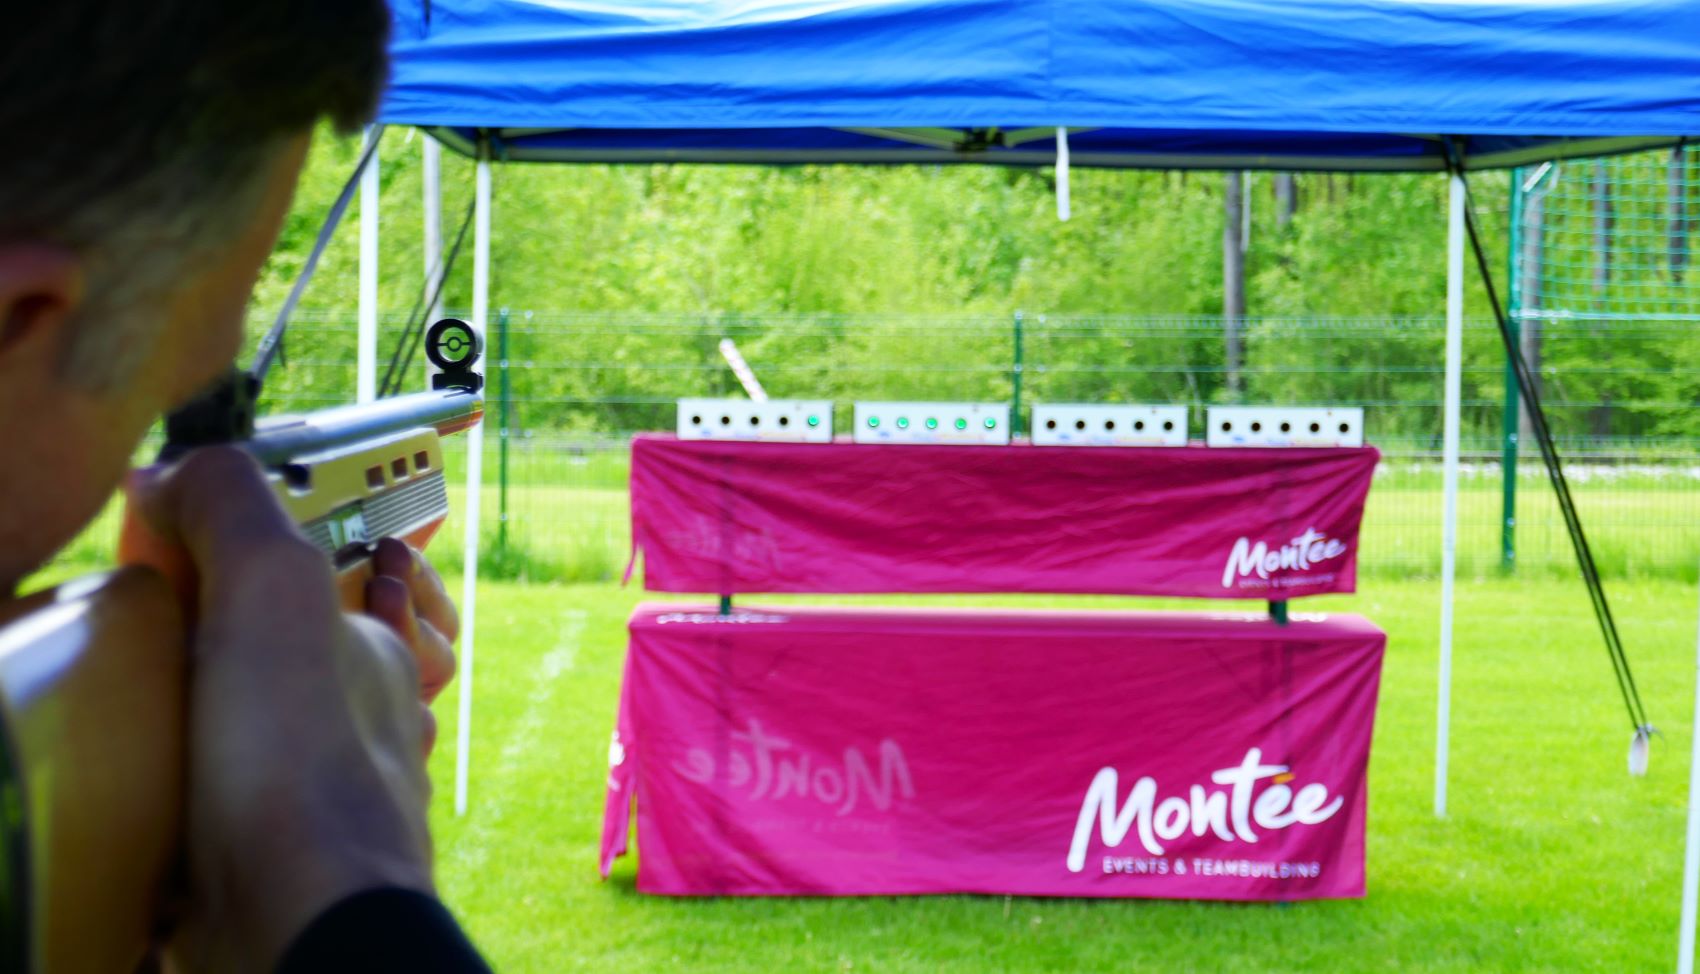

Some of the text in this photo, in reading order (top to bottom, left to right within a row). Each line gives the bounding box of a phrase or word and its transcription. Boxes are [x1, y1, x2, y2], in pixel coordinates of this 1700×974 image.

[1066, 747, 1344, 873] Montée
[1102, 856, 1321, 878] EVENTS & TEAMBUILDING
